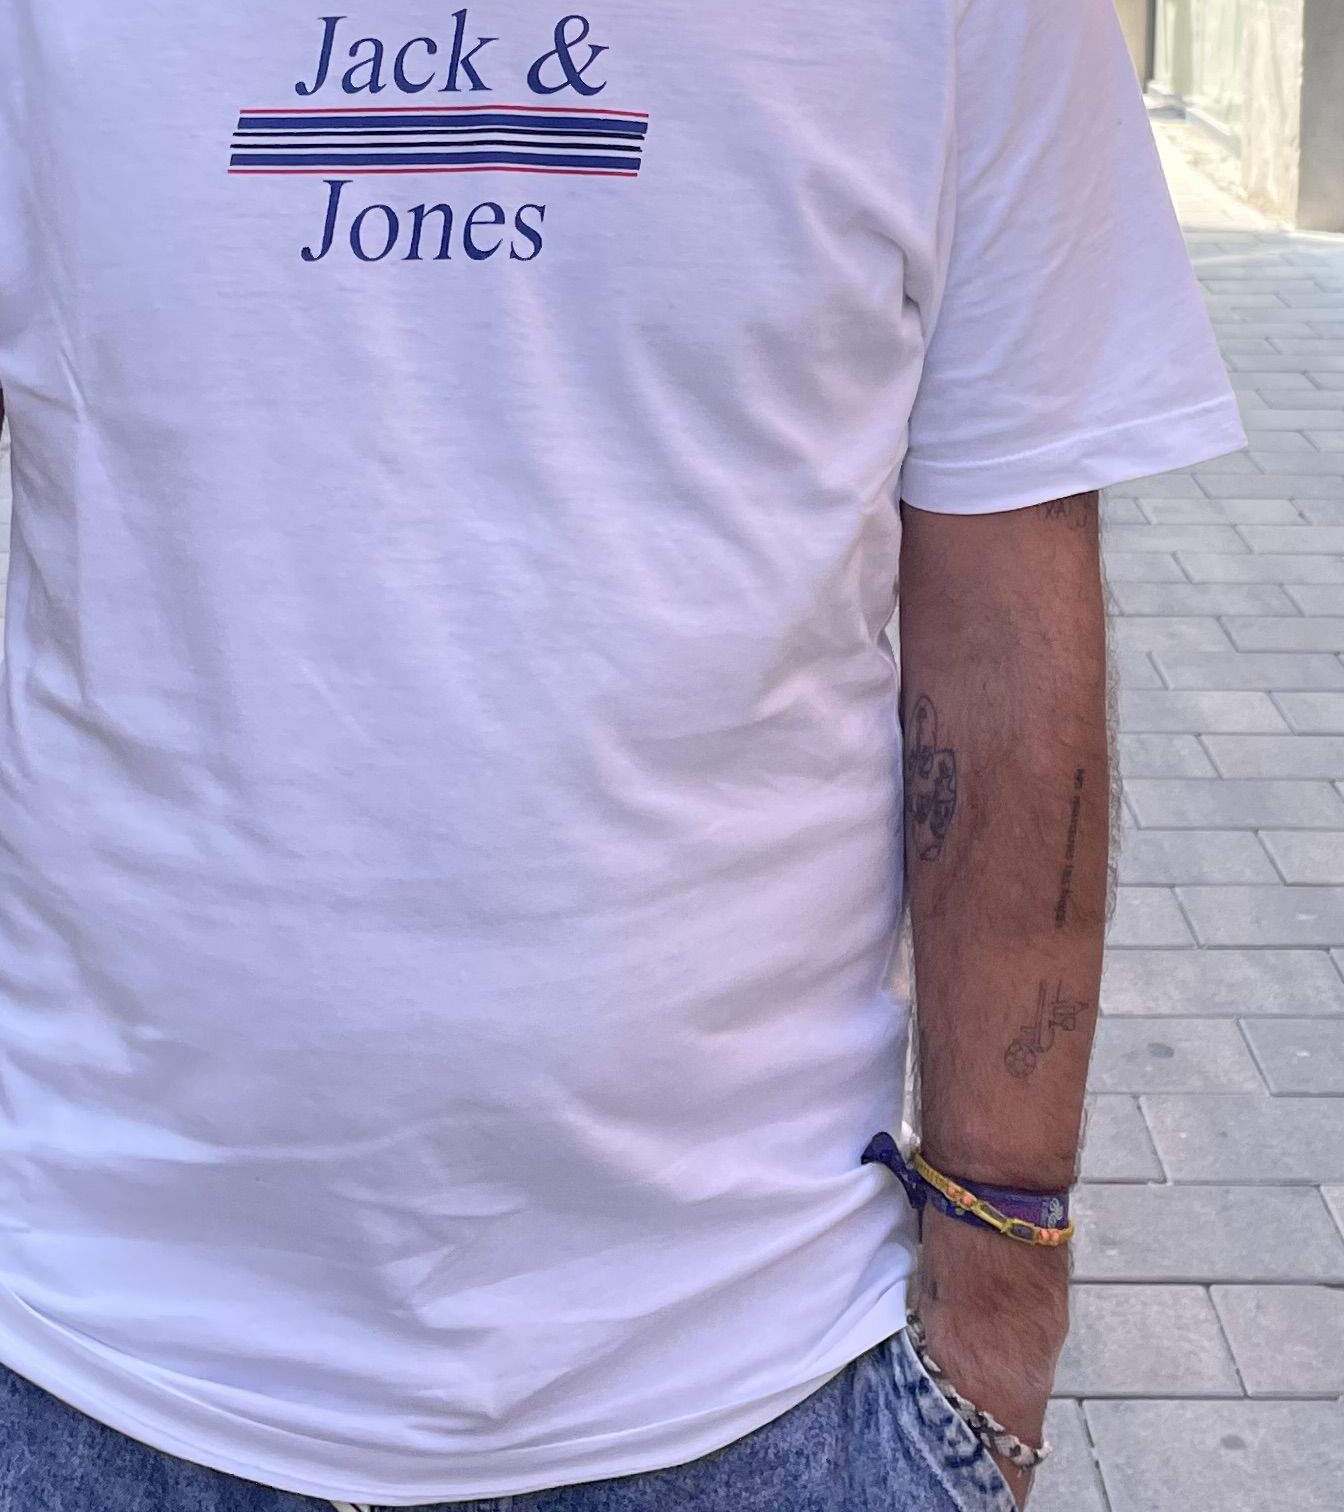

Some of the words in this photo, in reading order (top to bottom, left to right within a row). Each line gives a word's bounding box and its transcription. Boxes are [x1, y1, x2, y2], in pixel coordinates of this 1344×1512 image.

[294, 7, 500, 97] Jack
[526, 13, 610, 97] &
[300, 178, 547, 263] Jones
